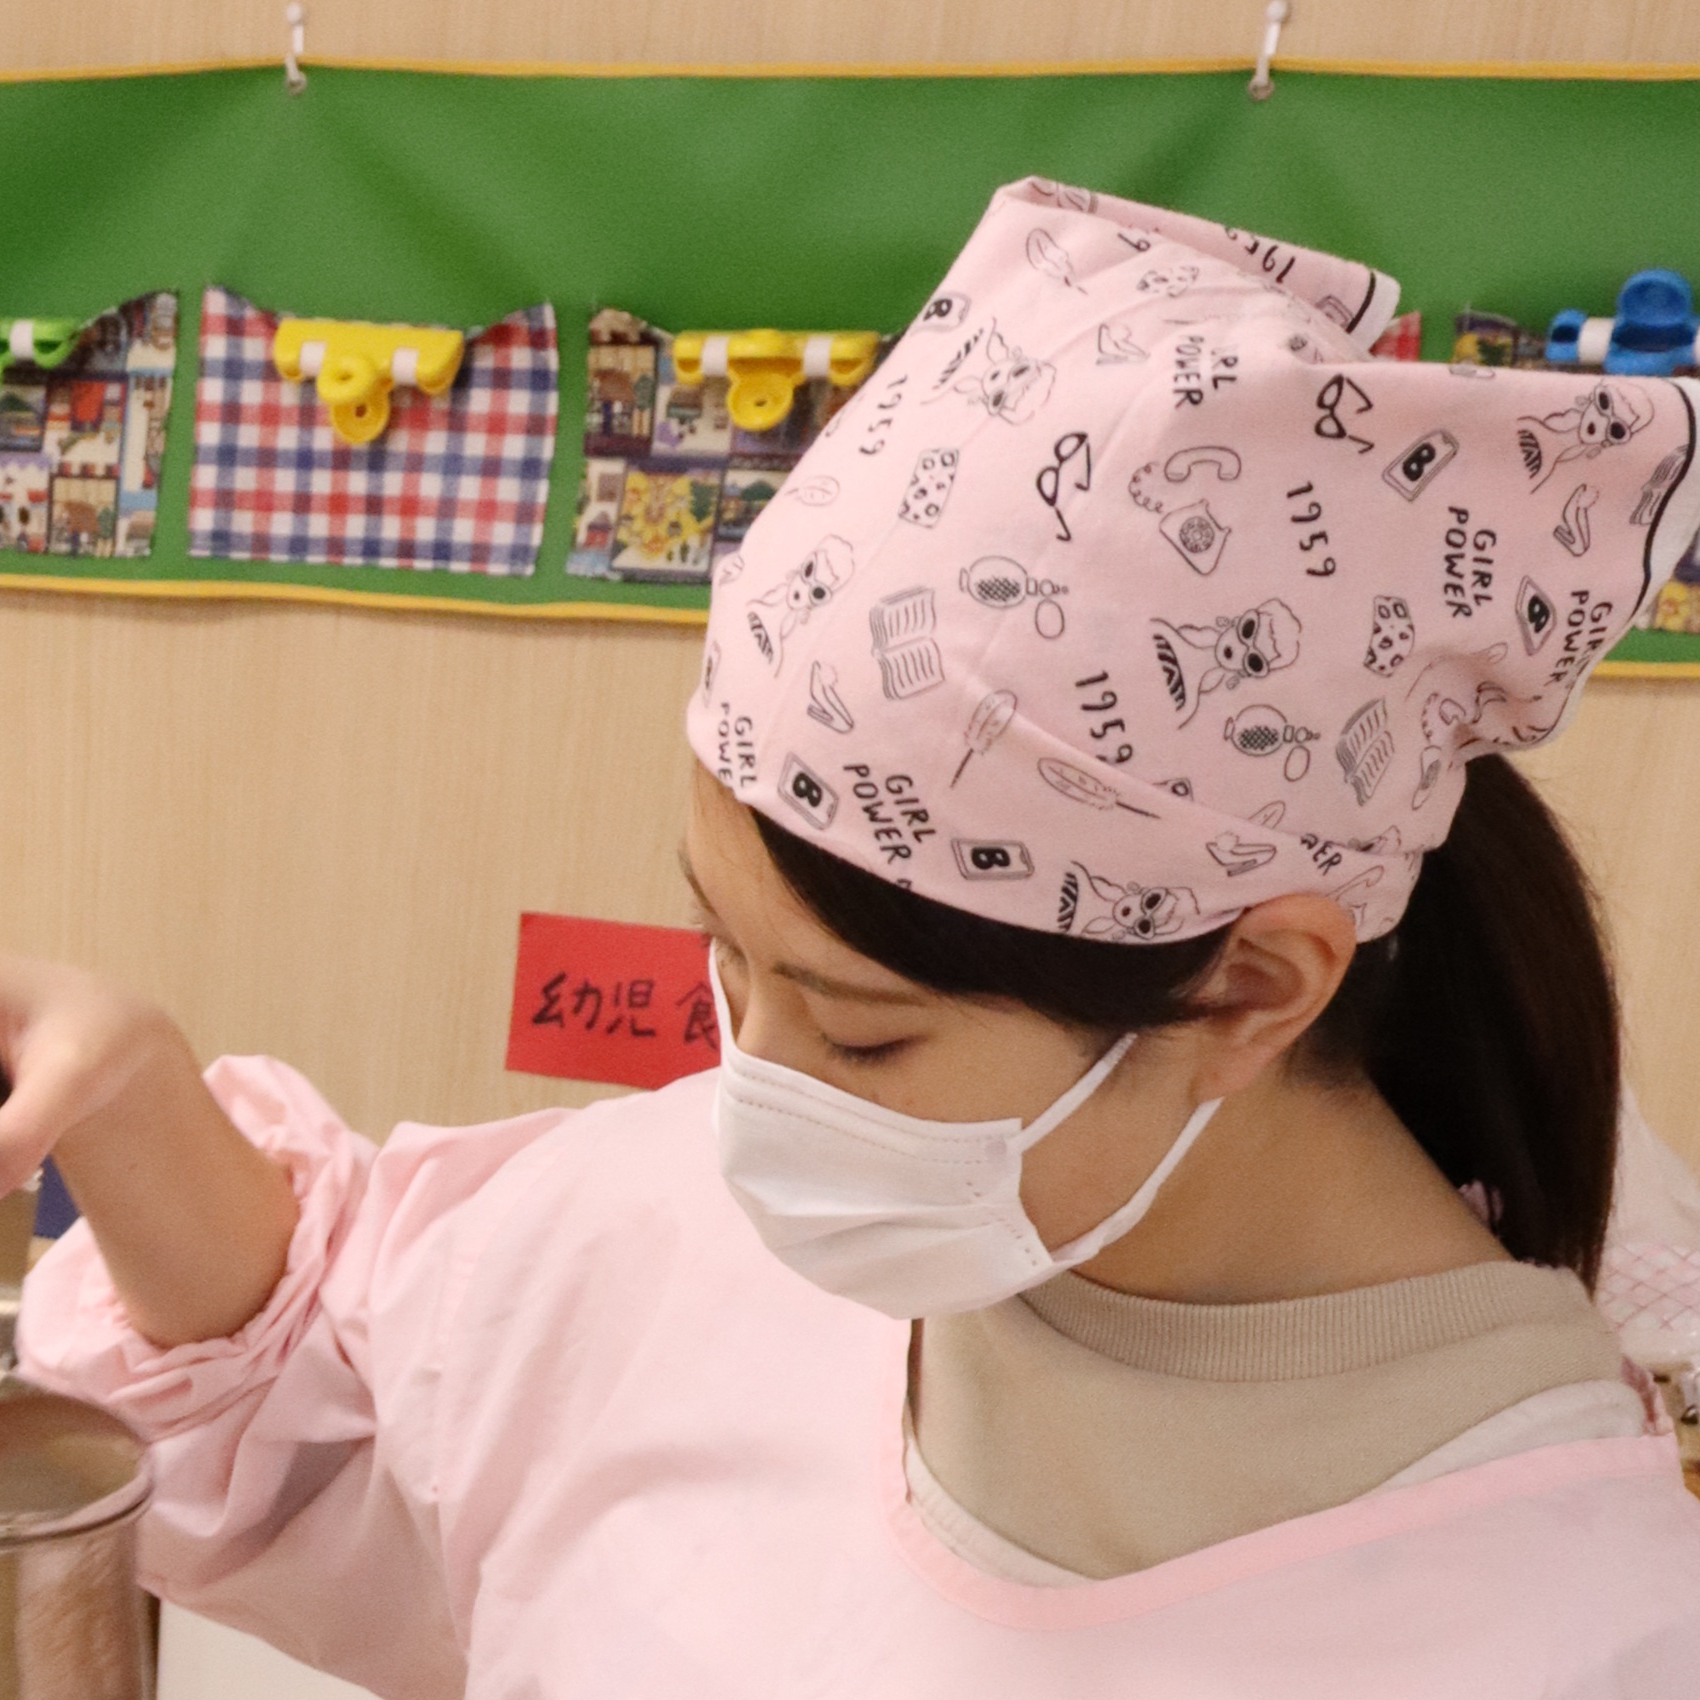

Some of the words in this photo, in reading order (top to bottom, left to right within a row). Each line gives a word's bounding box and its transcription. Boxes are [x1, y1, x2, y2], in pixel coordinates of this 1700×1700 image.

[1286, 481, 1337, 577] 1959
[1443, 506, 1473, 618] POWER
[1471, 529, 1498, 607] GIRL
[717, 702, 733, 780] POWE
[734, 715, 757, 788] GIRL
[1075, 670, 1133, 764] 1959
[843, 764, 912, 864] POWER
[885, 773, 936, 843] GIRL
